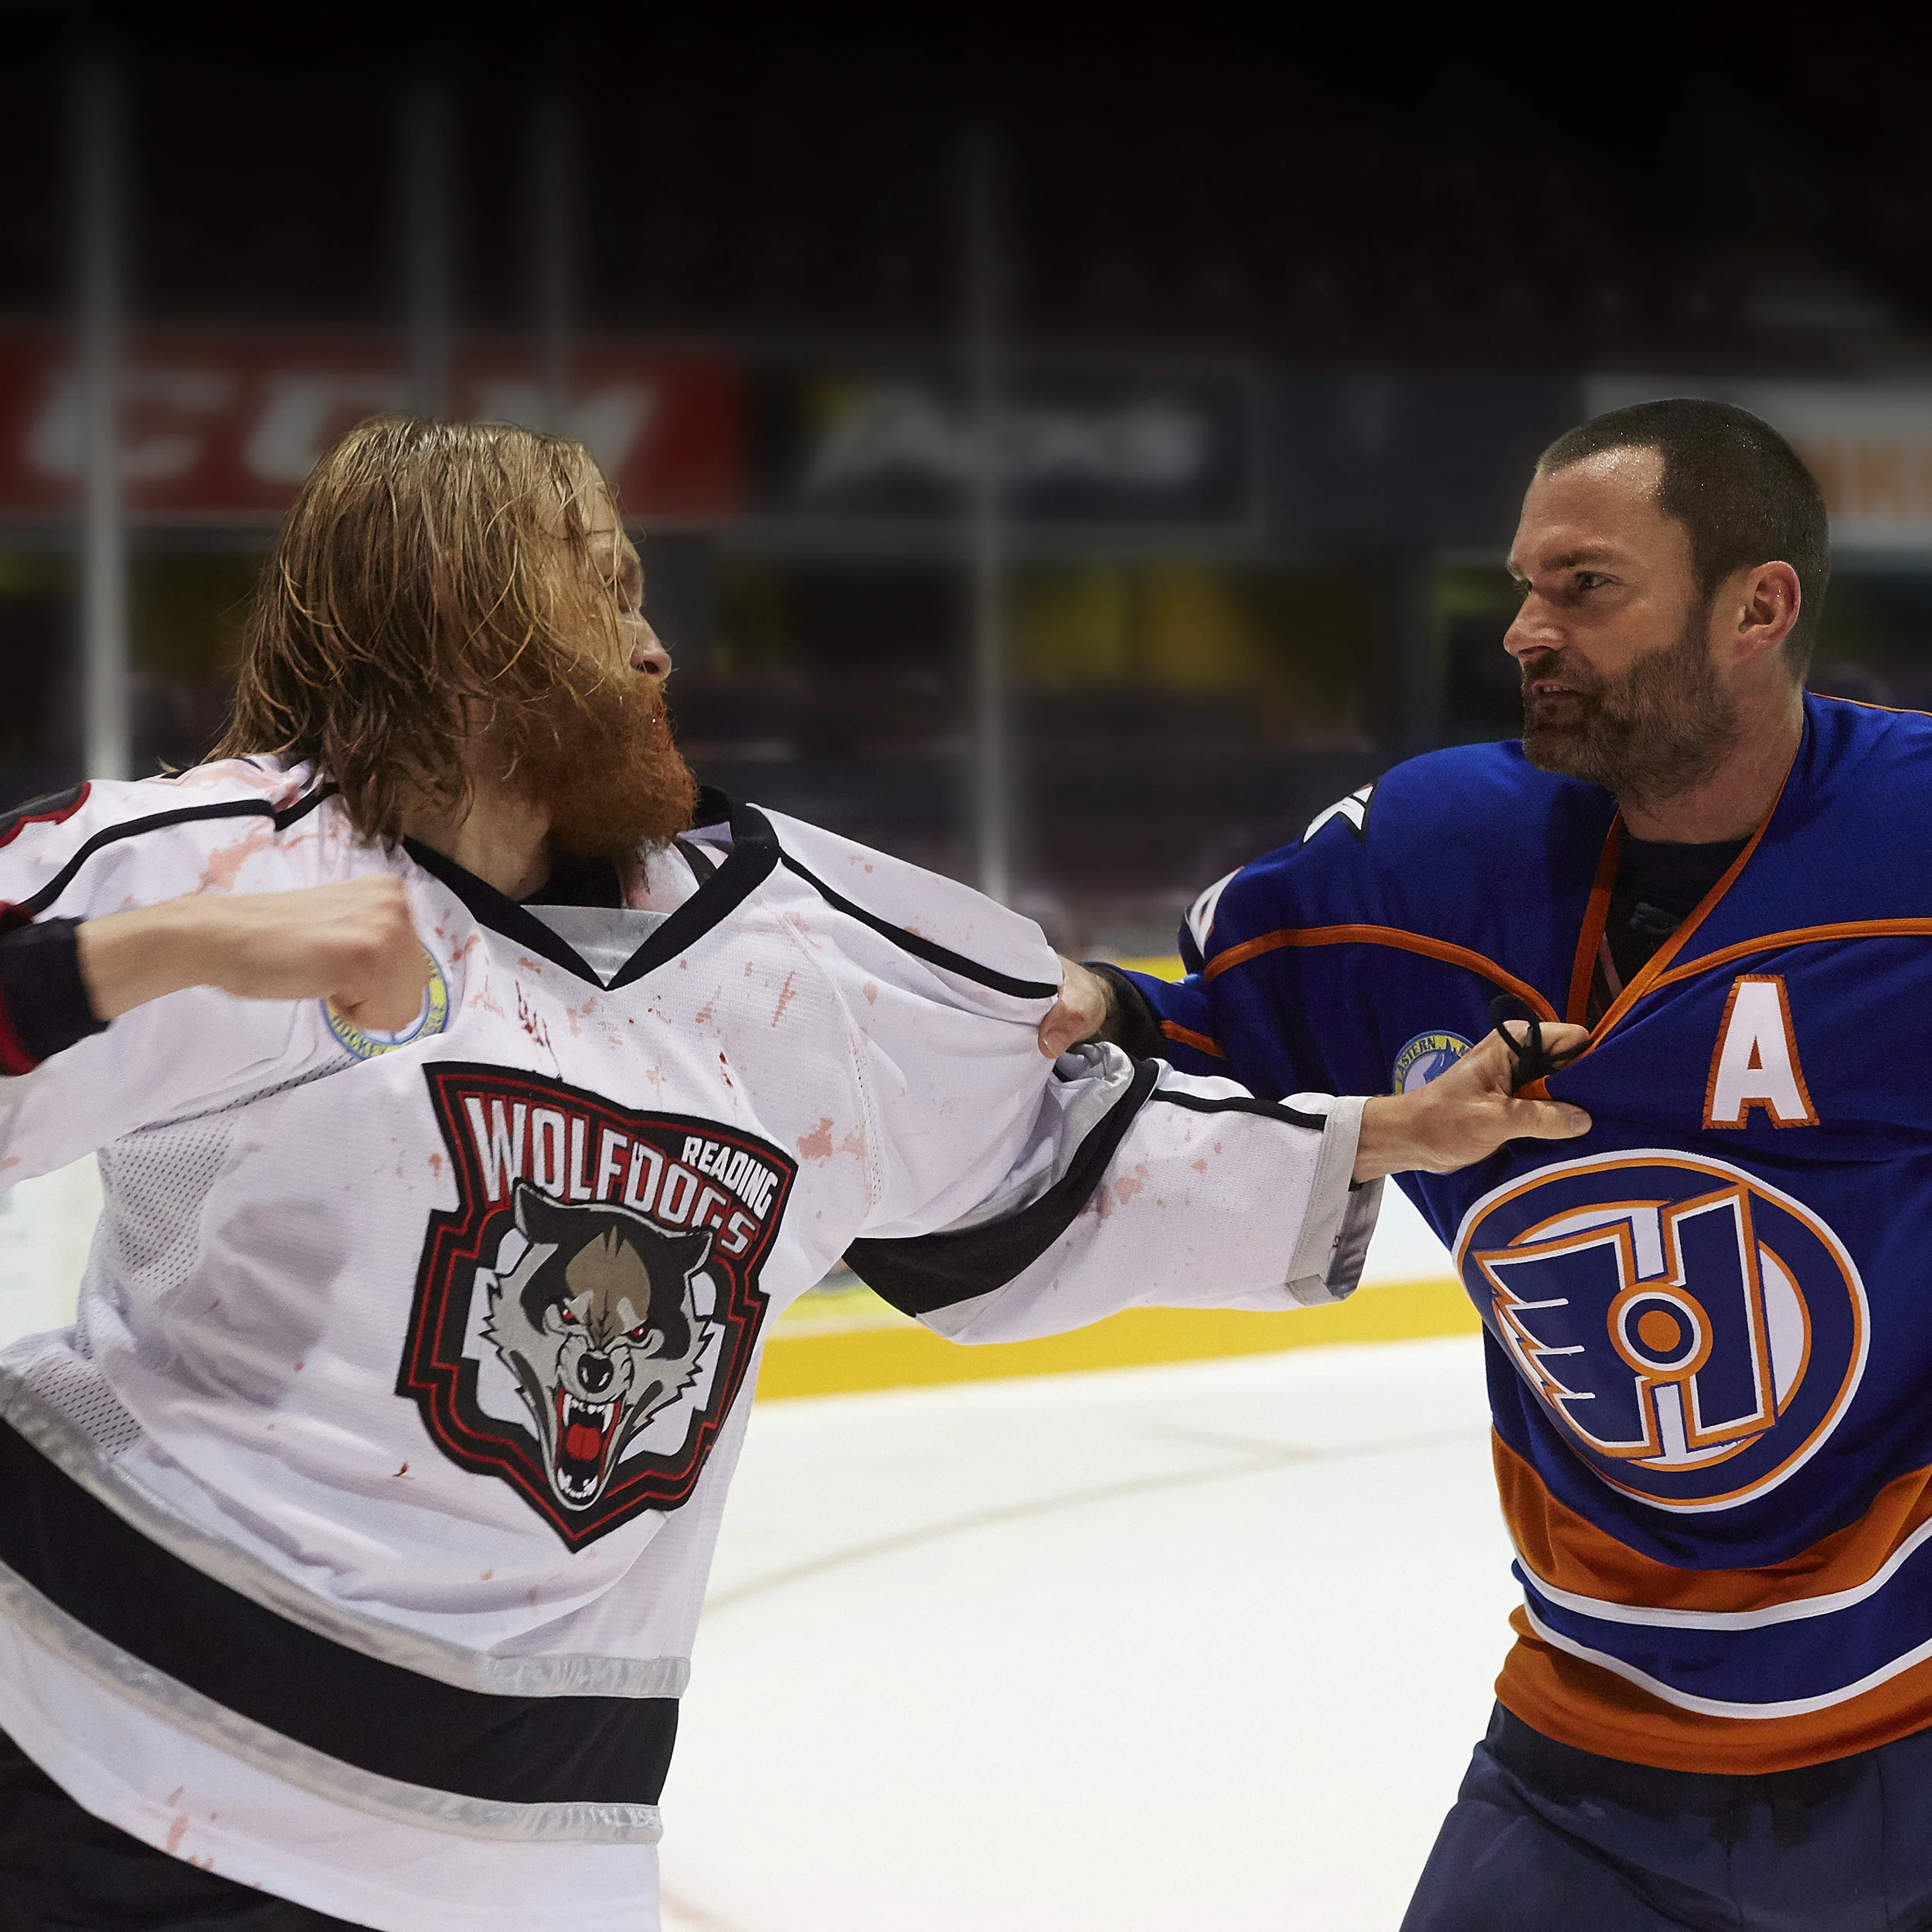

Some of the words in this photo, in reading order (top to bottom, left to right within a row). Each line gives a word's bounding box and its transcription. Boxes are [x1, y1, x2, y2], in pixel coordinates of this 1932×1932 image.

[1703, 975, 1819, 1129] A
[465, 1097, 756, 1254] WOLFDOGS
[682, 1137, 777, 1220] READING
